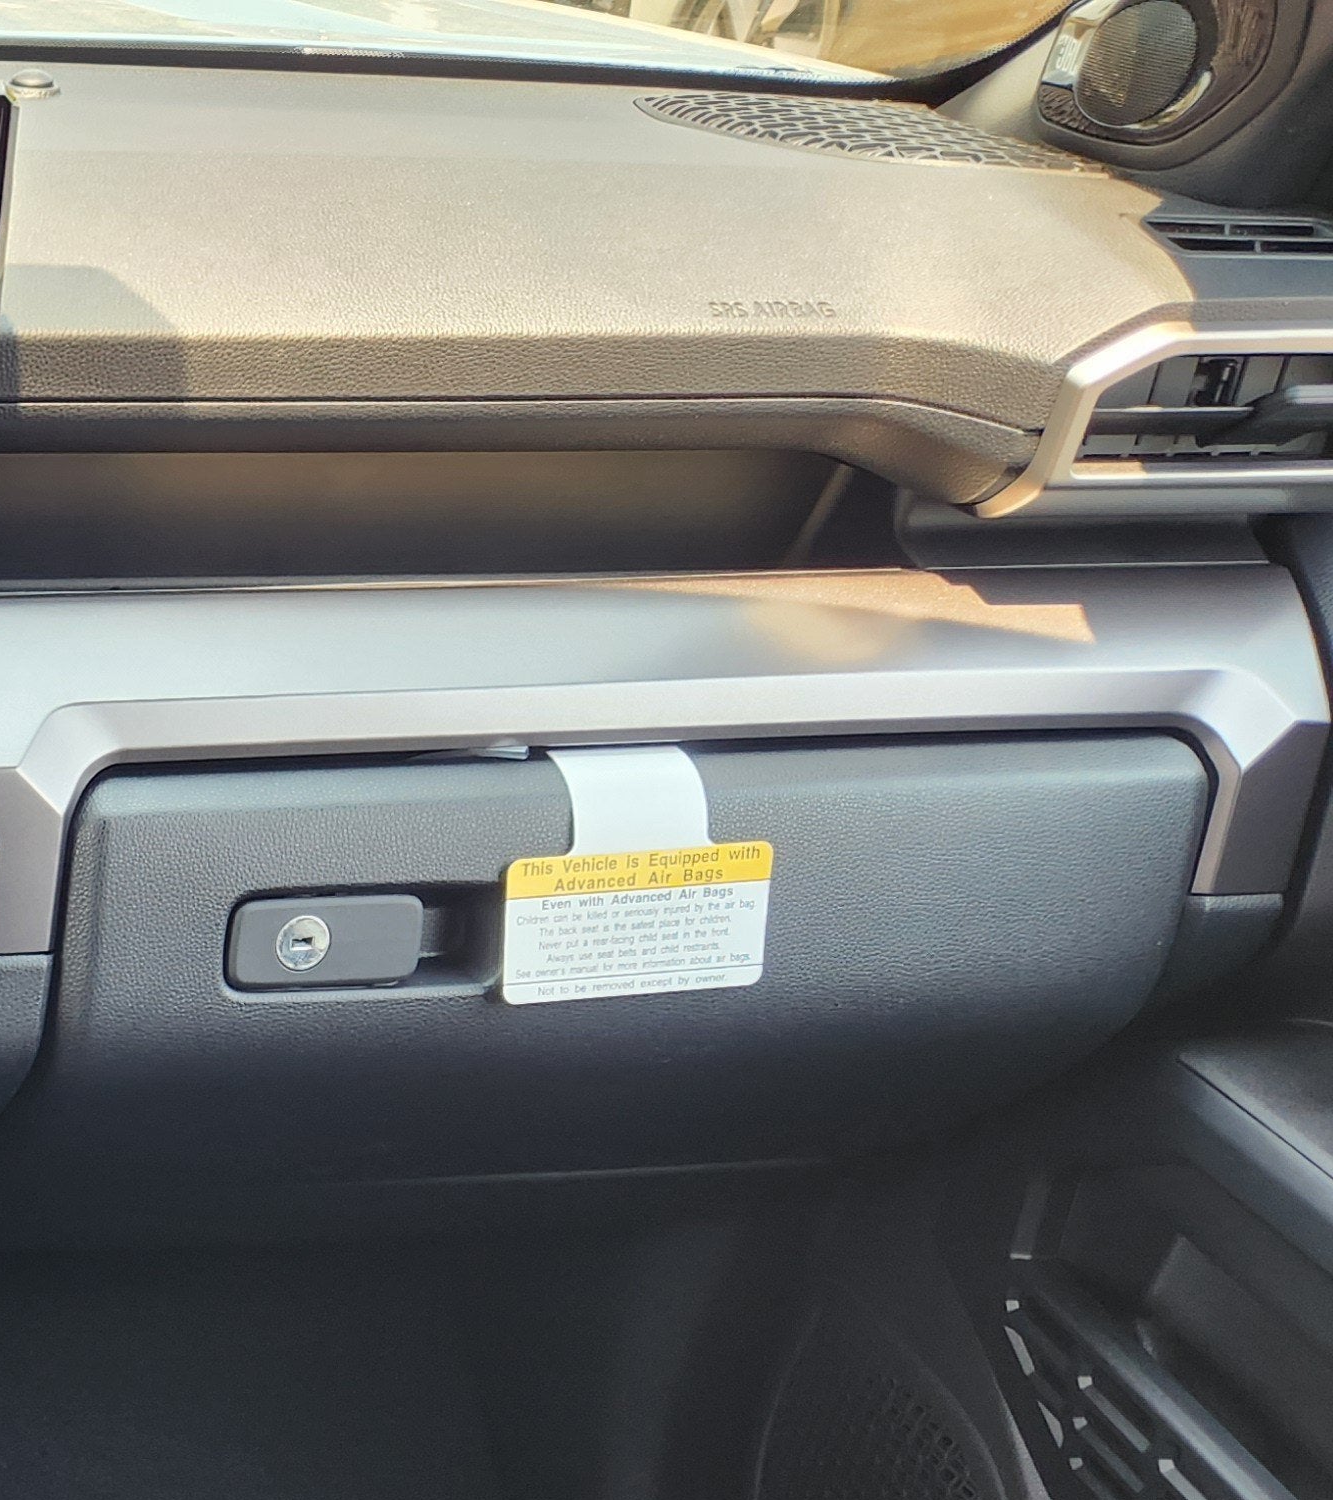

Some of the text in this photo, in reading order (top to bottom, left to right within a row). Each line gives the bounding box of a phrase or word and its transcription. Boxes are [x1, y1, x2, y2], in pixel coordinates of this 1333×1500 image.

[708, 301, 837, 318] SRS AIRBAG
[522, 846, 761, 877] This Vehicle is Equipped with
[554, 868, 724, 892] Advanced Air Bags
[541, 886, 734, 911] Even with Advanced Air Bags
[516, 913, 549, 926] Children
[553, 914, 568, 923] can
[586, 910, 608, 920] killed
[694, 903, 704, 914] by
[707, 902, 720, 911] the
[539, 927, 554, 937] The
[558, 926, 577, 936] back
[581, 924, 599, 934] seat
[614, 923, 627, 931] the
[658, 918, 681, 929] place
[685, 917, 696, 926] for
[538, 941, 562, 951] Never
[566, 940, 579, 950] put
[639, 933, 658, 943] child
[661, 931, 679, 941] seat
[683, 931, 691, 939] in
[695, 929, 707, 938] the
[546, 953, 574, 964] Always
[579, 952, 593, 961] use
[597, 950, 614, 959] seat
[618, 948, 637, 957] belts
[641, 946, 657, 956] and
[660, 944, 679, 954] child
[515, 969, 532, 979] See
[570, 964, 599, 974] manual
[603, 962, 613, 971] for
[617, 962, 638, 970] more
[642, 957, 686, 968] information
[689, 955, 712, 965] about
[537, 986, 555, 996] Not
[559, 986, 570, 995] to
[574, 984, 587, 993] be
[592, 980, 635, 992] removed
[640, 977, 673, 990] except
[677, 975, 690, 986] by
